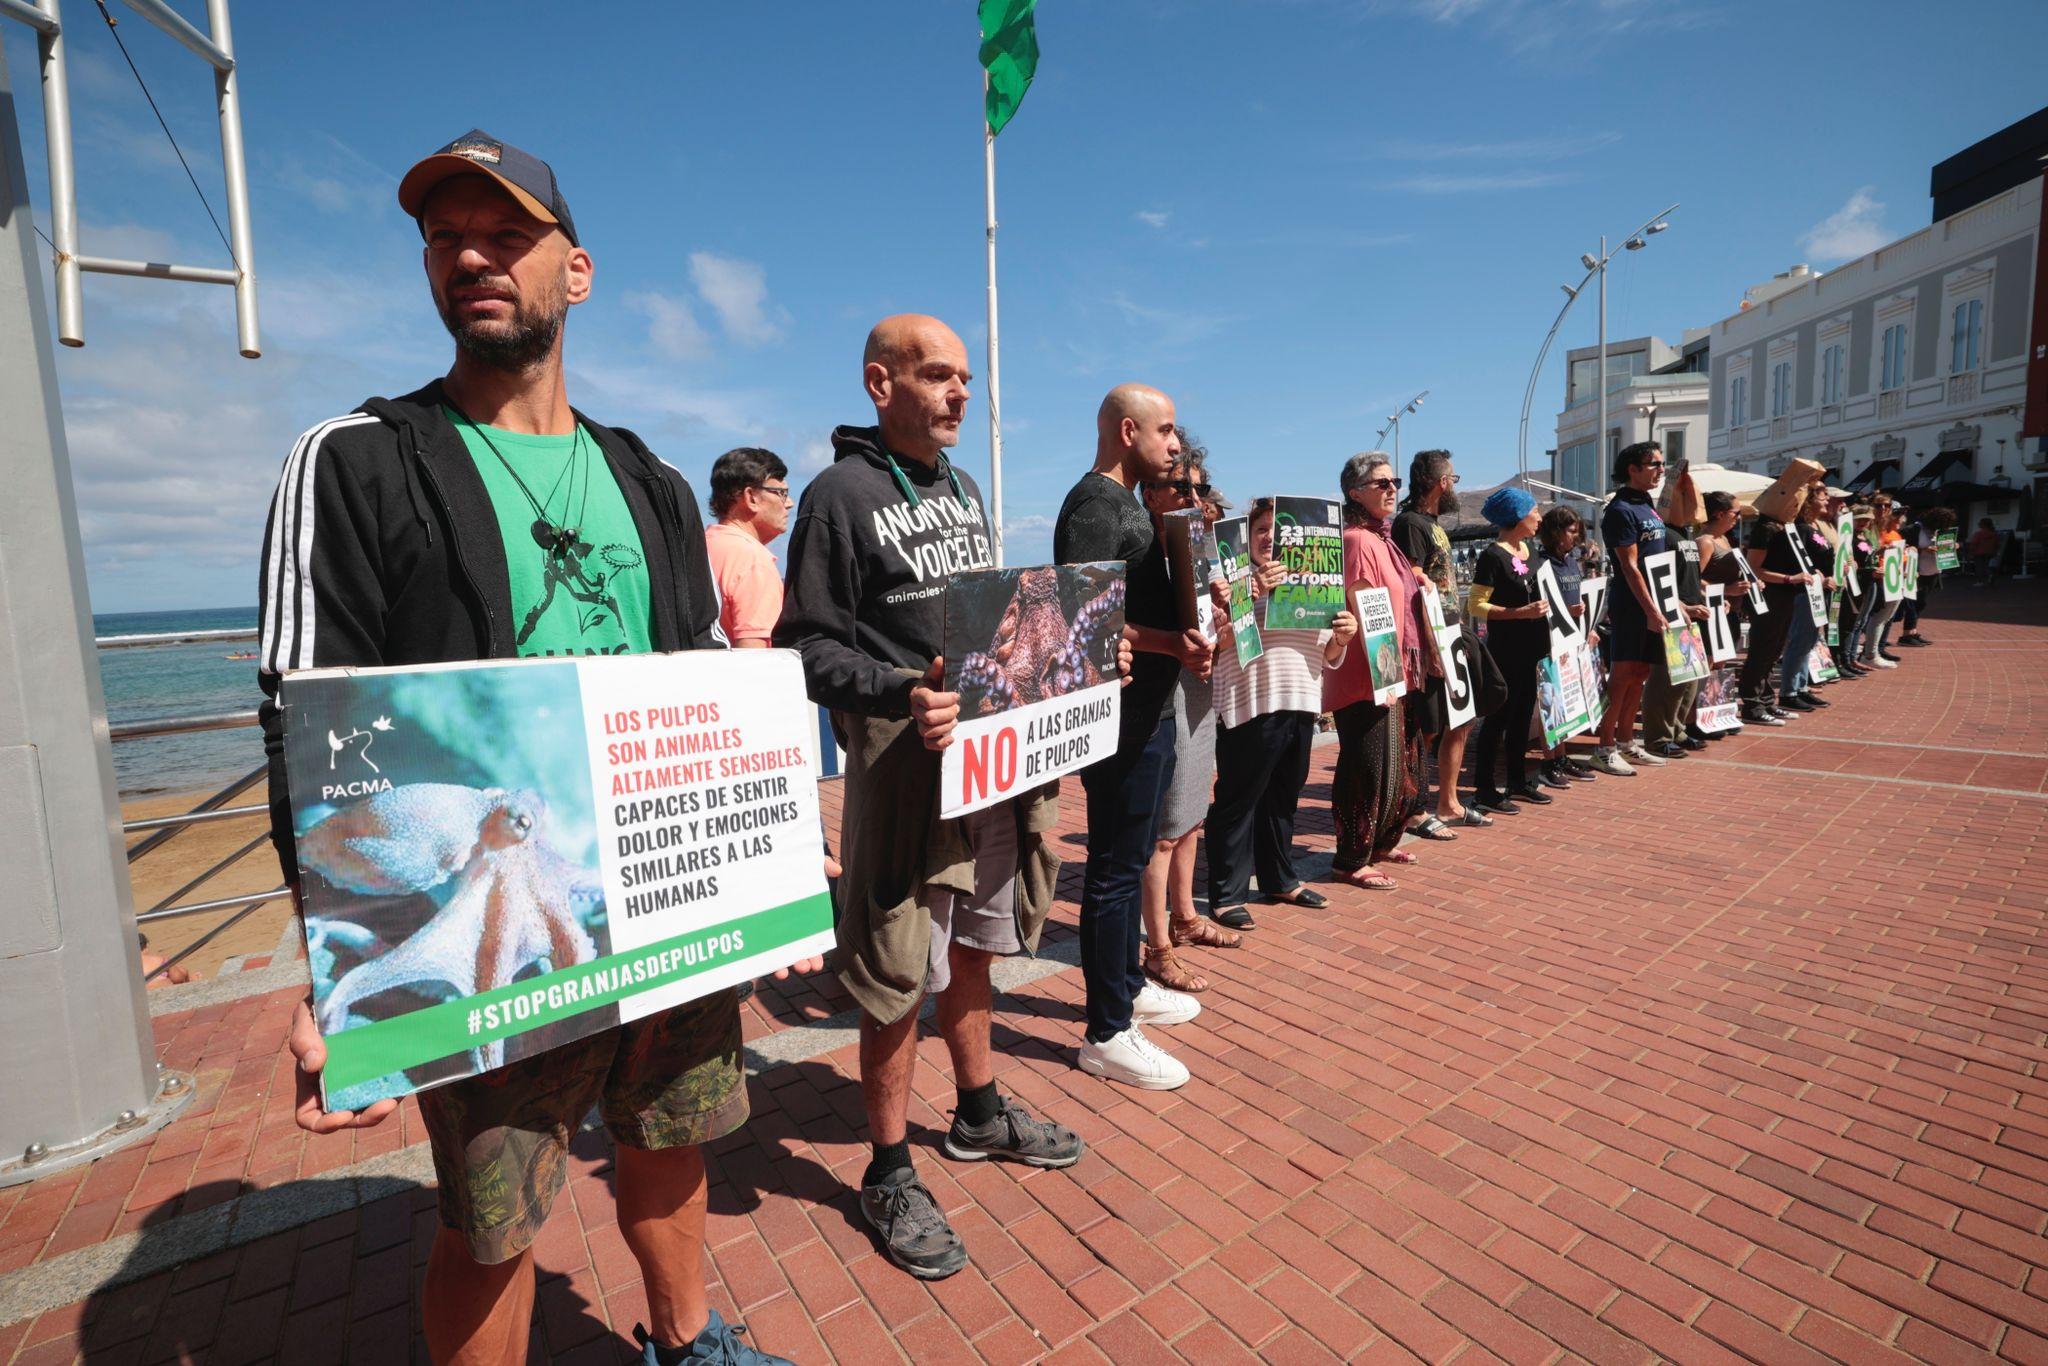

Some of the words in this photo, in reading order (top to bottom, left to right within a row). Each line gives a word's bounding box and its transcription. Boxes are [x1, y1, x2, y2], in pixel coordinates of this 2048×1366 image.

[954, 525, 968, 536] the
[1280, 525, 1304, 537] 23
[1280, 536, 1304, 546] APR
[1305, 536, 1341, 547] ACTION
[1280, 547, 1341, 573] AGAINST
[1885, 555, 1899, 594] O
[1274, 585, 1344, 604] FARM
[1361, 595, 1370, 604] LOS
[1370, 592, 1386, 603] PULPOS
[1364, 603, 1389, 616] MERECEN
[1651, 563, 1679, 623] E
[1365, 616, 1393, 632] LIBERTAD
[1709, 595, 1725, 650] T
[1450, 636, 1470, 711] S
[604, 710, 642, 735] LOS
[647, 702, 720, 729] PULPOS
[1027, 721, 1035, 745] A
[1039, 713, 1061, 741] LAS
[1065, 697, 1112, 732] GRANJAS
[607, 740, 647, 765] SON
[654, 728, 743, 759] ANIMALES
[963, 727, 1018, 805] NO
[1026, 750, 1041, 779] DE
[1046, 734, 1090, 770] PULPOS
[322, 778, 393, 800] PACMA
[612, 760, 715, 796] ALTAMENTE
[720, 746, 807, 778] SENSIBLES,
[614, 791, 700, 827] CAPACES
[705, 786, 728, 809] DE
[733, 776, 788, 804] SENTIR
[618, 825, 683, 857] DOLOR
[689, 821, 699, 842] Y
[705, 801, 798, 838] EMOCIONES
[620, 846, 721, 888] SIMILARES
[727, 842, 738, 863] A
[743, 834, 773, 859] LAS
[625, 876, 719, 919] HUMANAS
[467, 929, 744, 1035] #STOPGRANJASDEPULPOS
